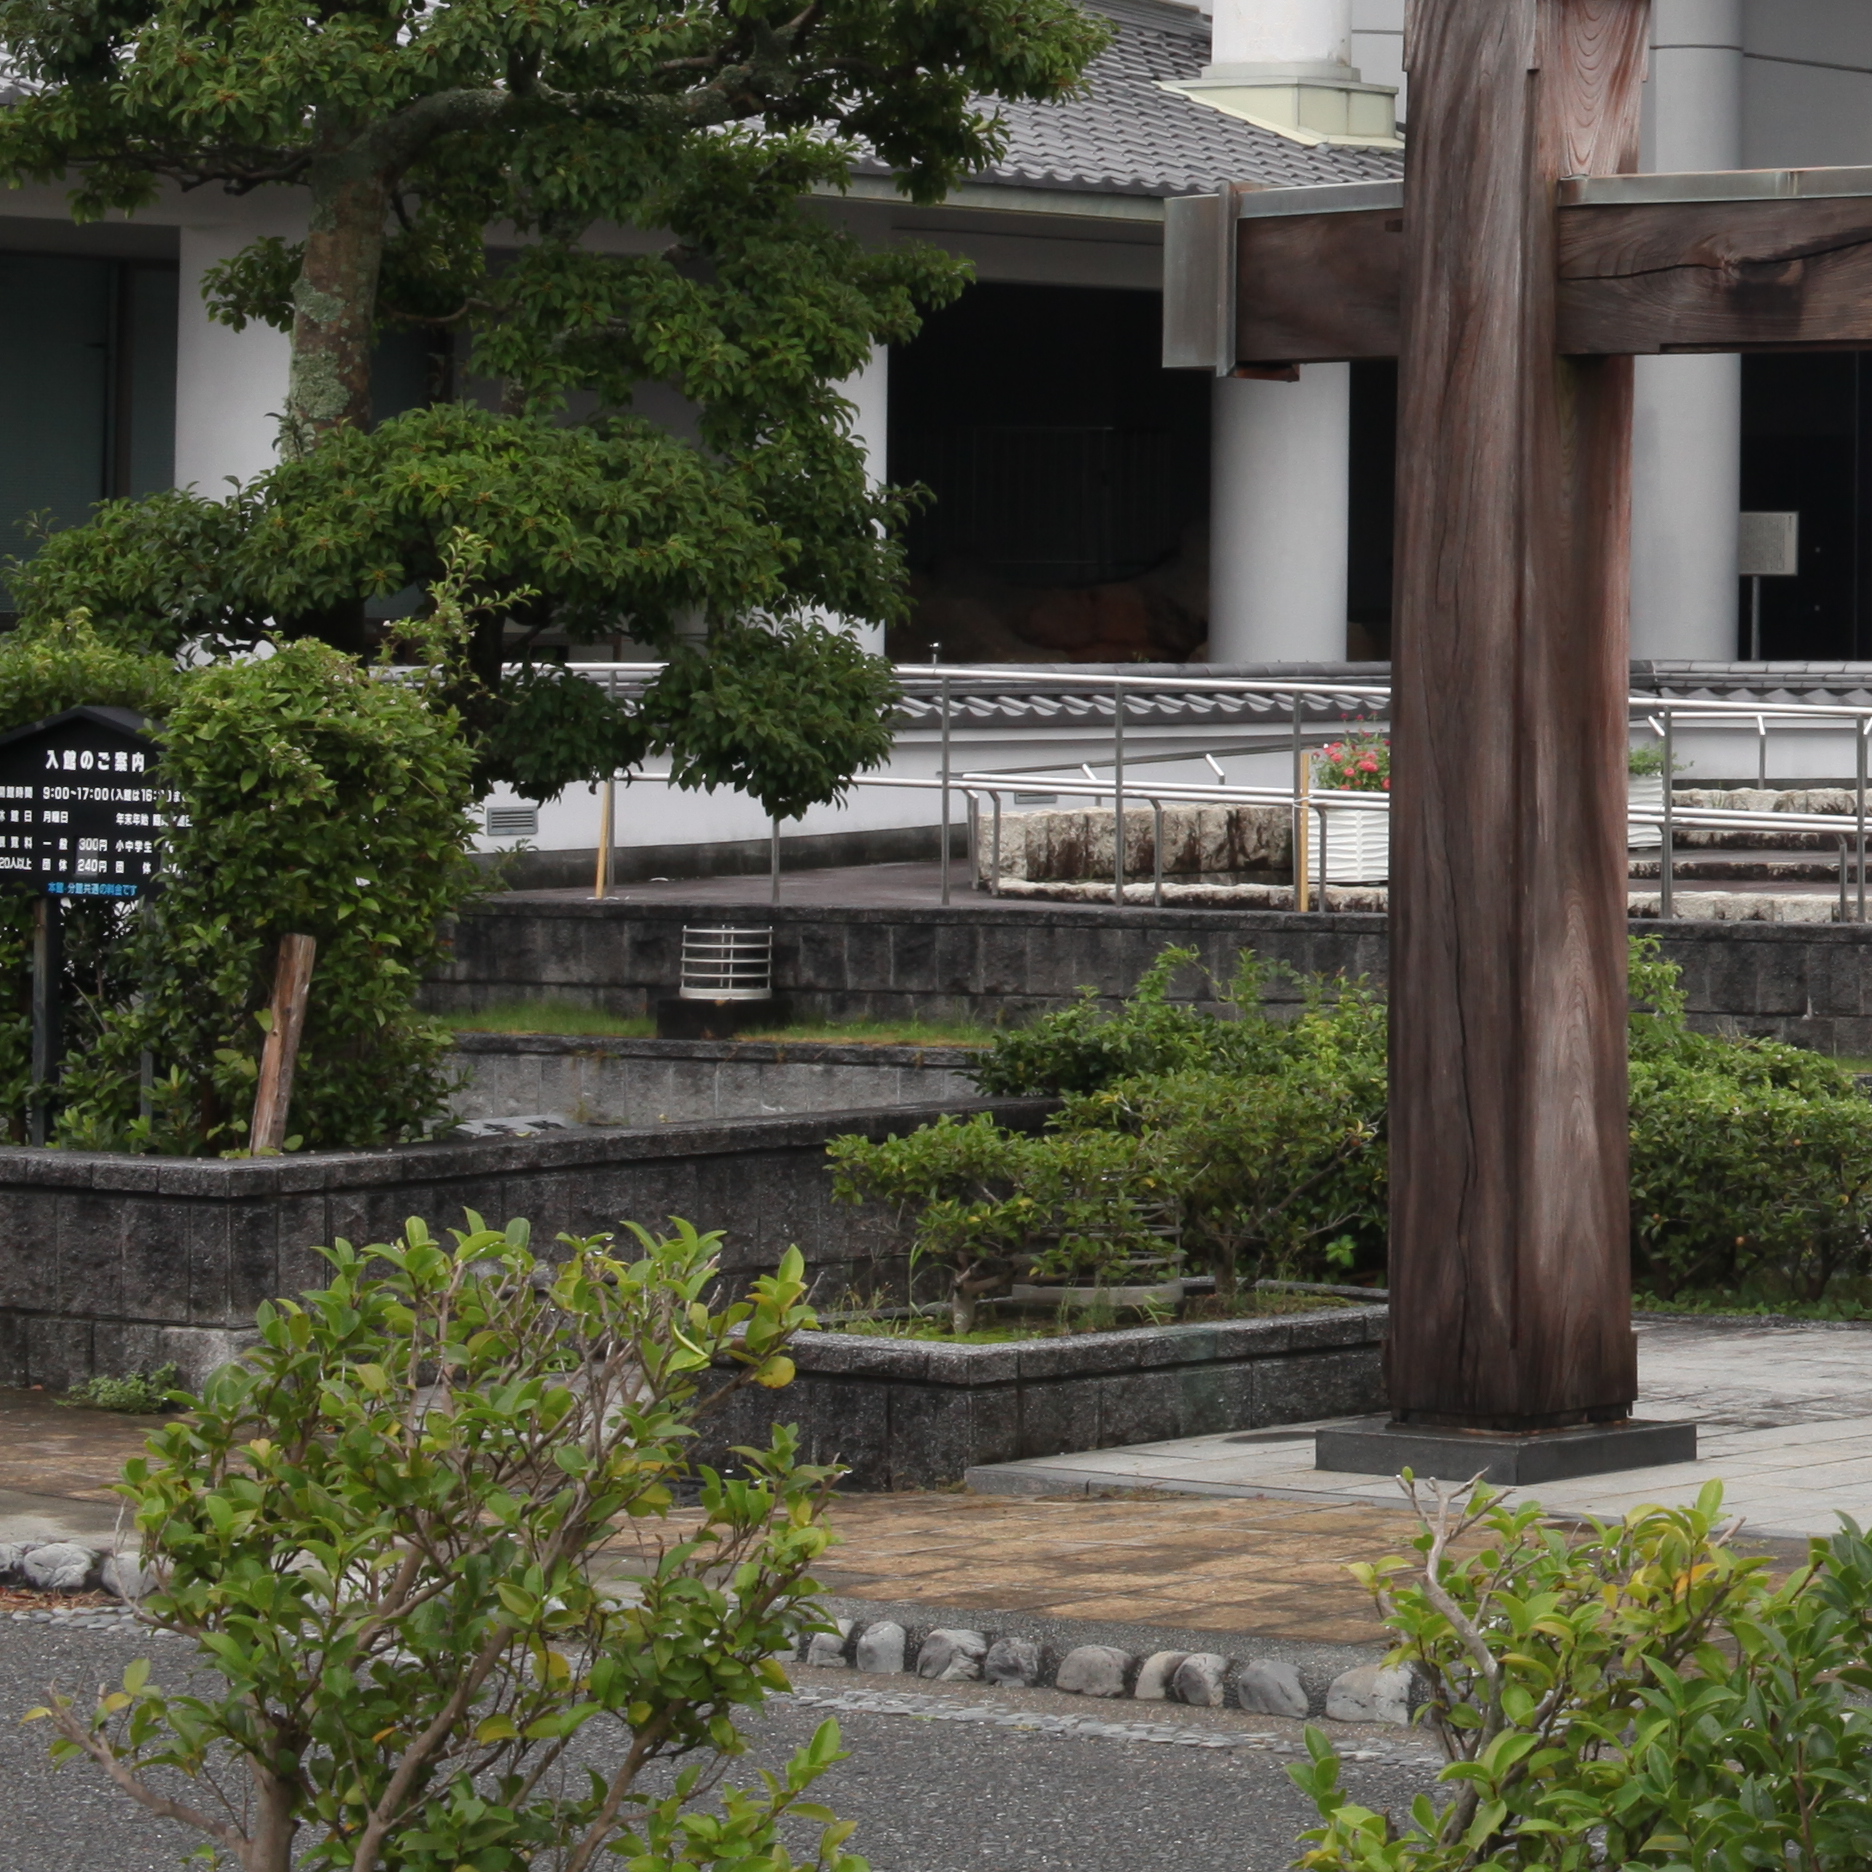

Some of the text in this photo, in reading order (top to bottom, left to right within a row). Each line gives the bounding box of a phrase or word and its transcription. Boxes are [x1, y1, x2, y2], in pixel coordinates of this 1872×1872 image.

[45, 749, 145, 773] 入館のご案内
[43, 810, 69, 823] 月曜日
[115, 812, 149, 826] 年末年始
[78, 837, 108, 852] 300円
[115, 839, 153, 853] 小中学生
[77, 858, 108, 874] 240円
